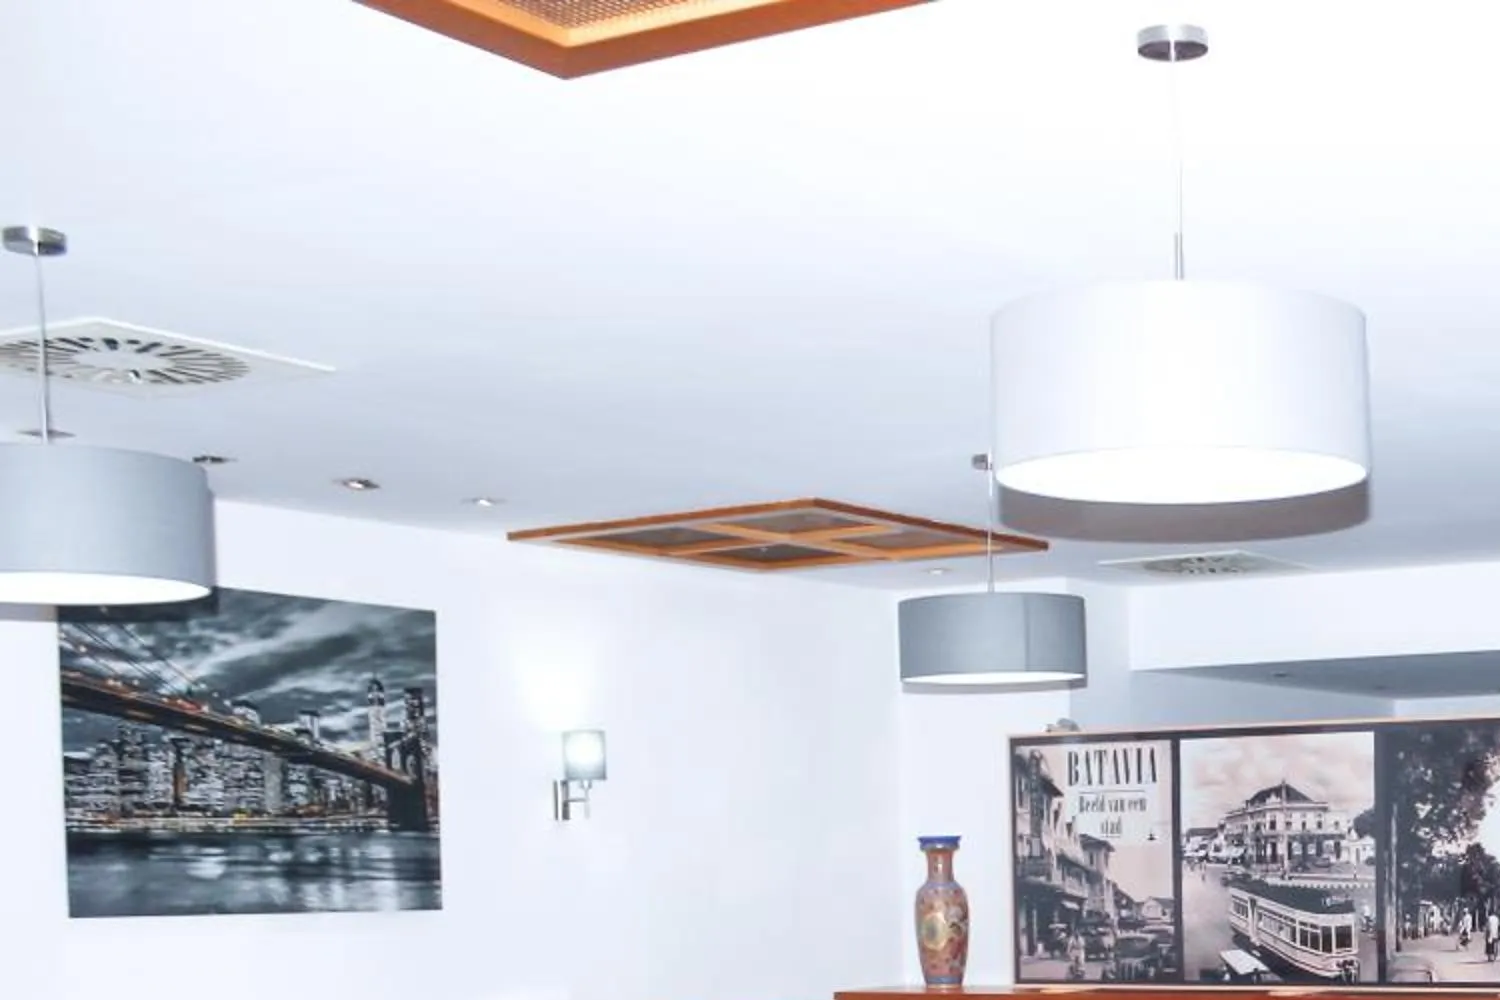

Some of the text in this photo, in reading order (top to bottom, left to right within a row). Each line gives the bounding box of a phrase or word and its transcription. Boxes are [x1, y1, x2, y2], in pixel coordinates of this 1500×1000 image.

[1067, 747, 1157, 786] BATAVIA
[1079, 794, 1146, 813] Beeld van een
[1100, 816, 1122, 835] stad
